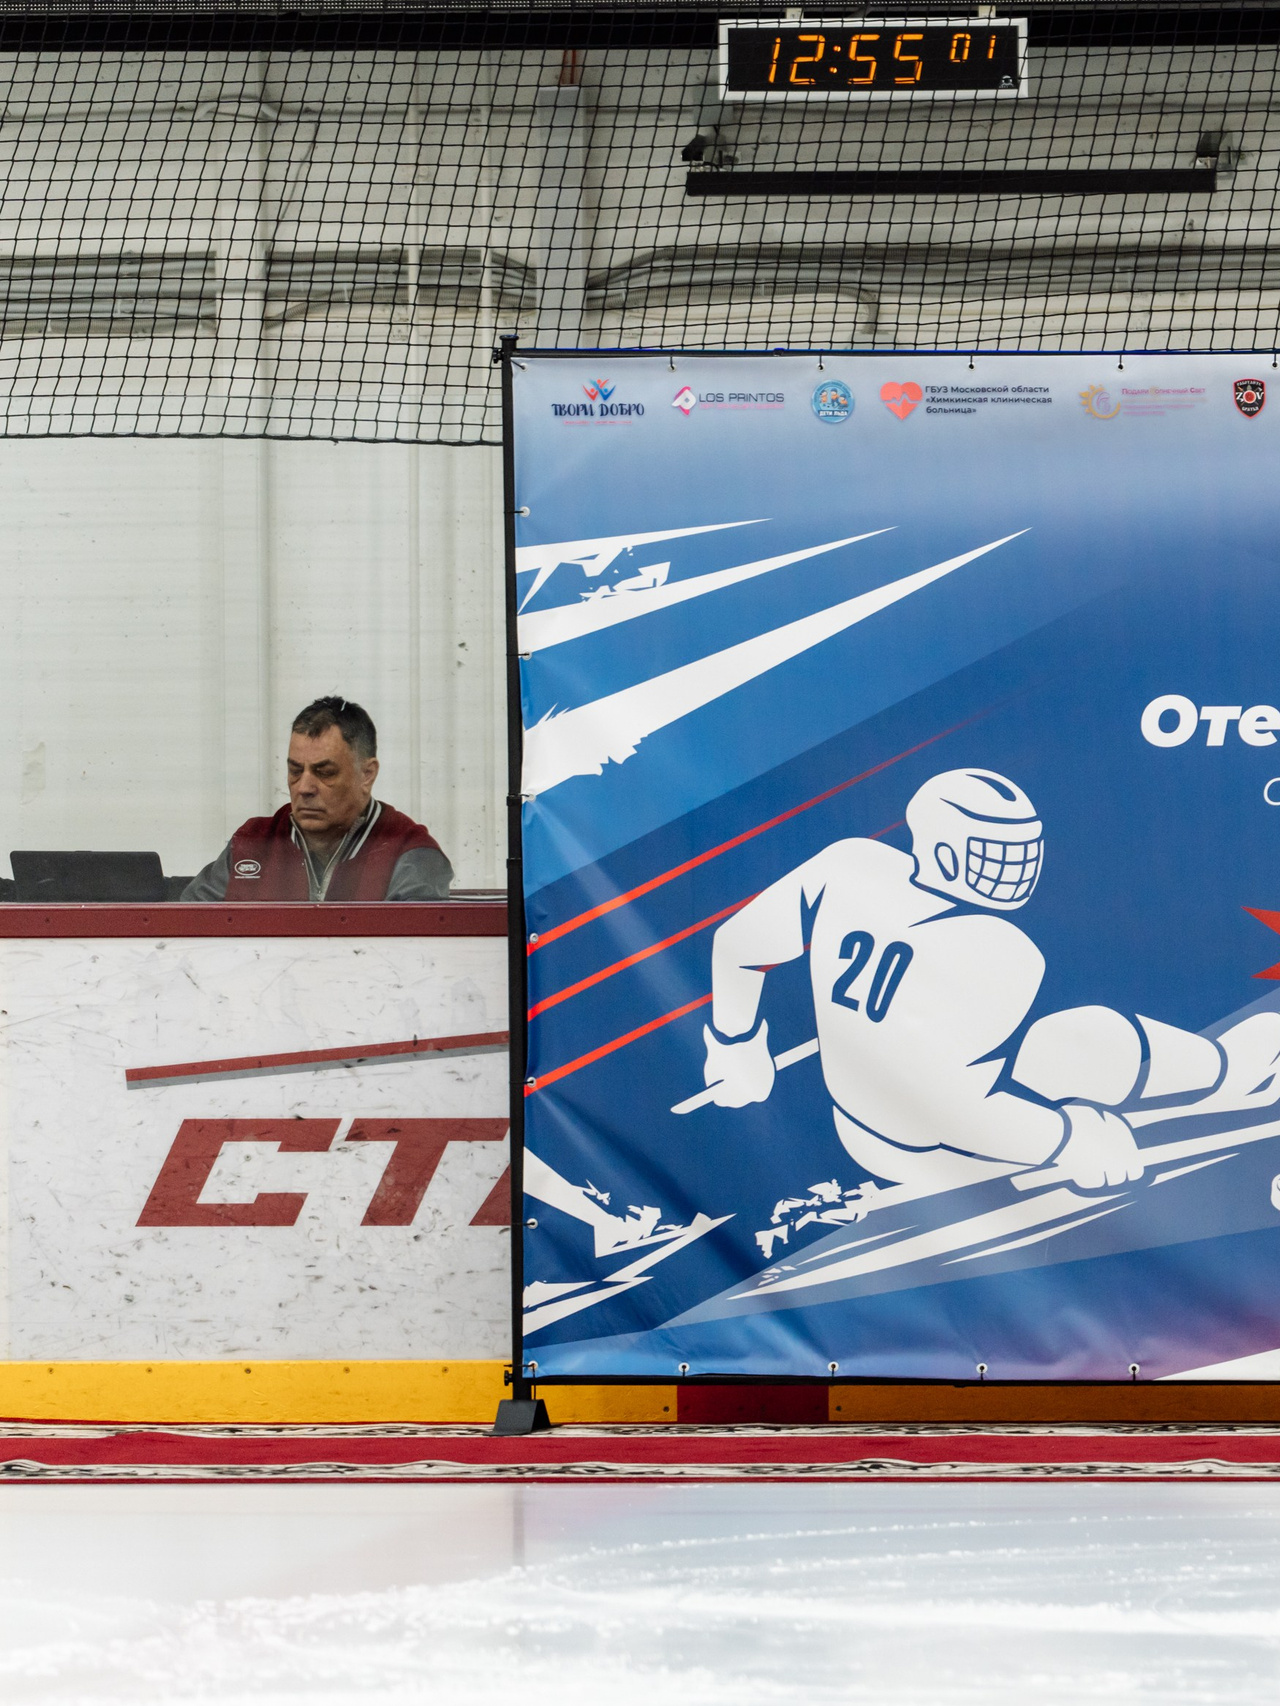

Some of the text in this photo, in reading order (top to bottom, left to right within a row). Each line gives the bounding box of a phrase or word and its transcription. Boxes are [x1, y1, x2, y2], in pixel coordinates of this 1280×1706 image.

[768, 33, 996, 85] 12:55 01
[925, 384, 1050, 394] ГБУЗ Московской области
[698, 392, 785, 403] LOS PRINTOS
[925, 396, 1053, 404] «Химкинская клиническая
[551, 402, 645, 417] ТВОРИ ДОБРО
[926, 406, 977, 415] больница»
[831, 930, 914, 1023] 20
